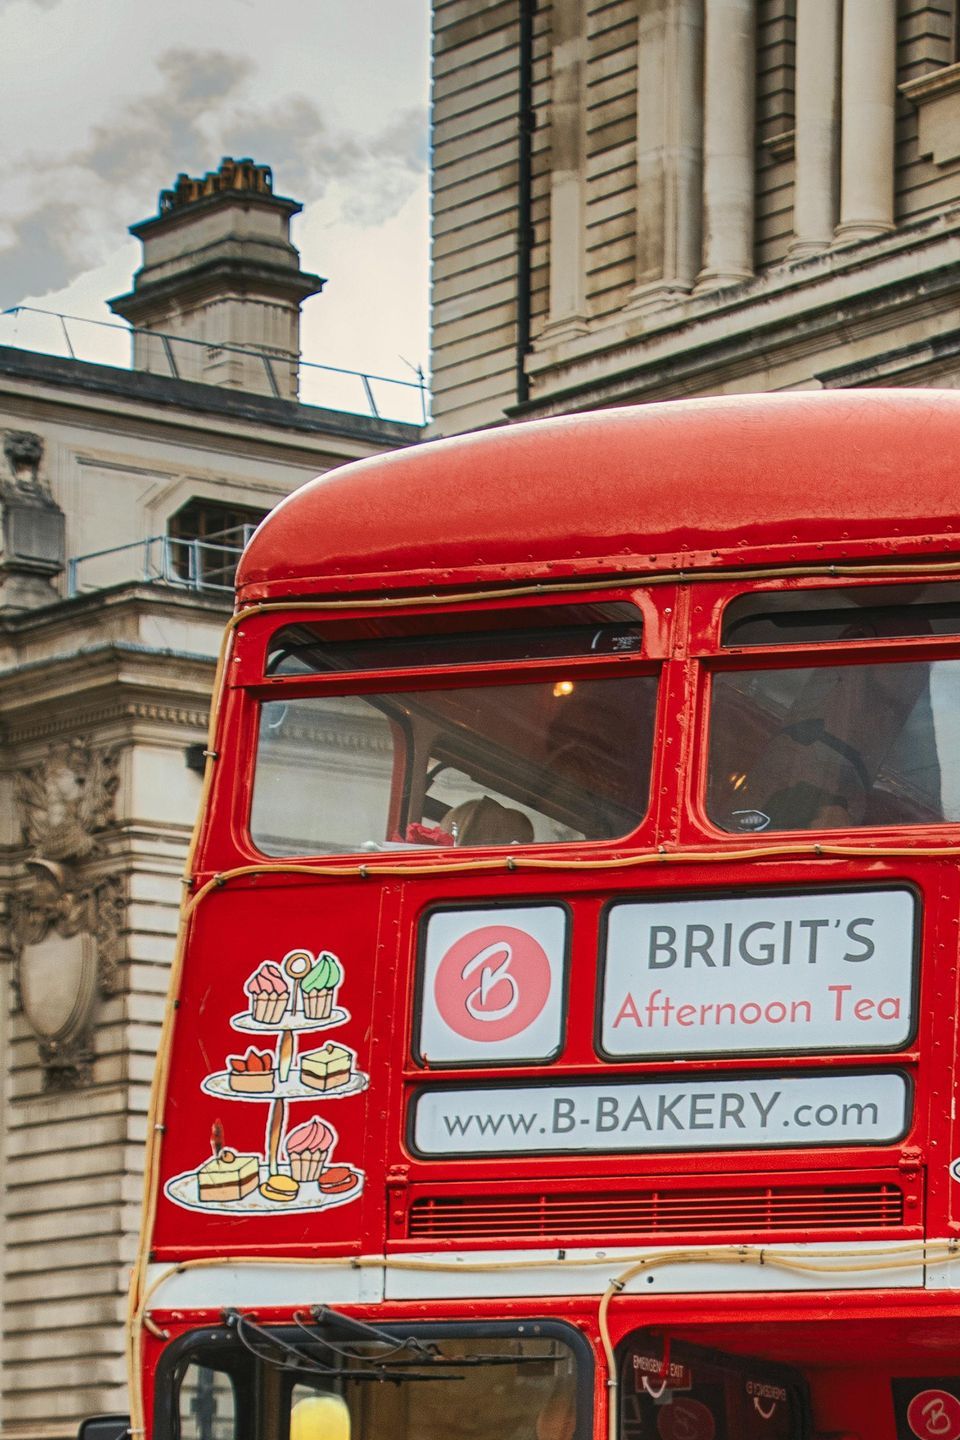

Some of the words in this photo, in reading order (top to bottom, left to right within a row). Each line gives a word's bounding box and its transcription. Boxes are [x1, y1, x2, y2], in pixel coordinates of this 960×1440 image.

[648, 917, 875, 969] BRIGIT'S
[612, 989, 812, 1028] Afternoon
[827, 984, 901, 1021] Tea
[443, 1091, 878, 1136] www.B-BAKERY.com
[670, 1364, 684, 1378] EXIT
